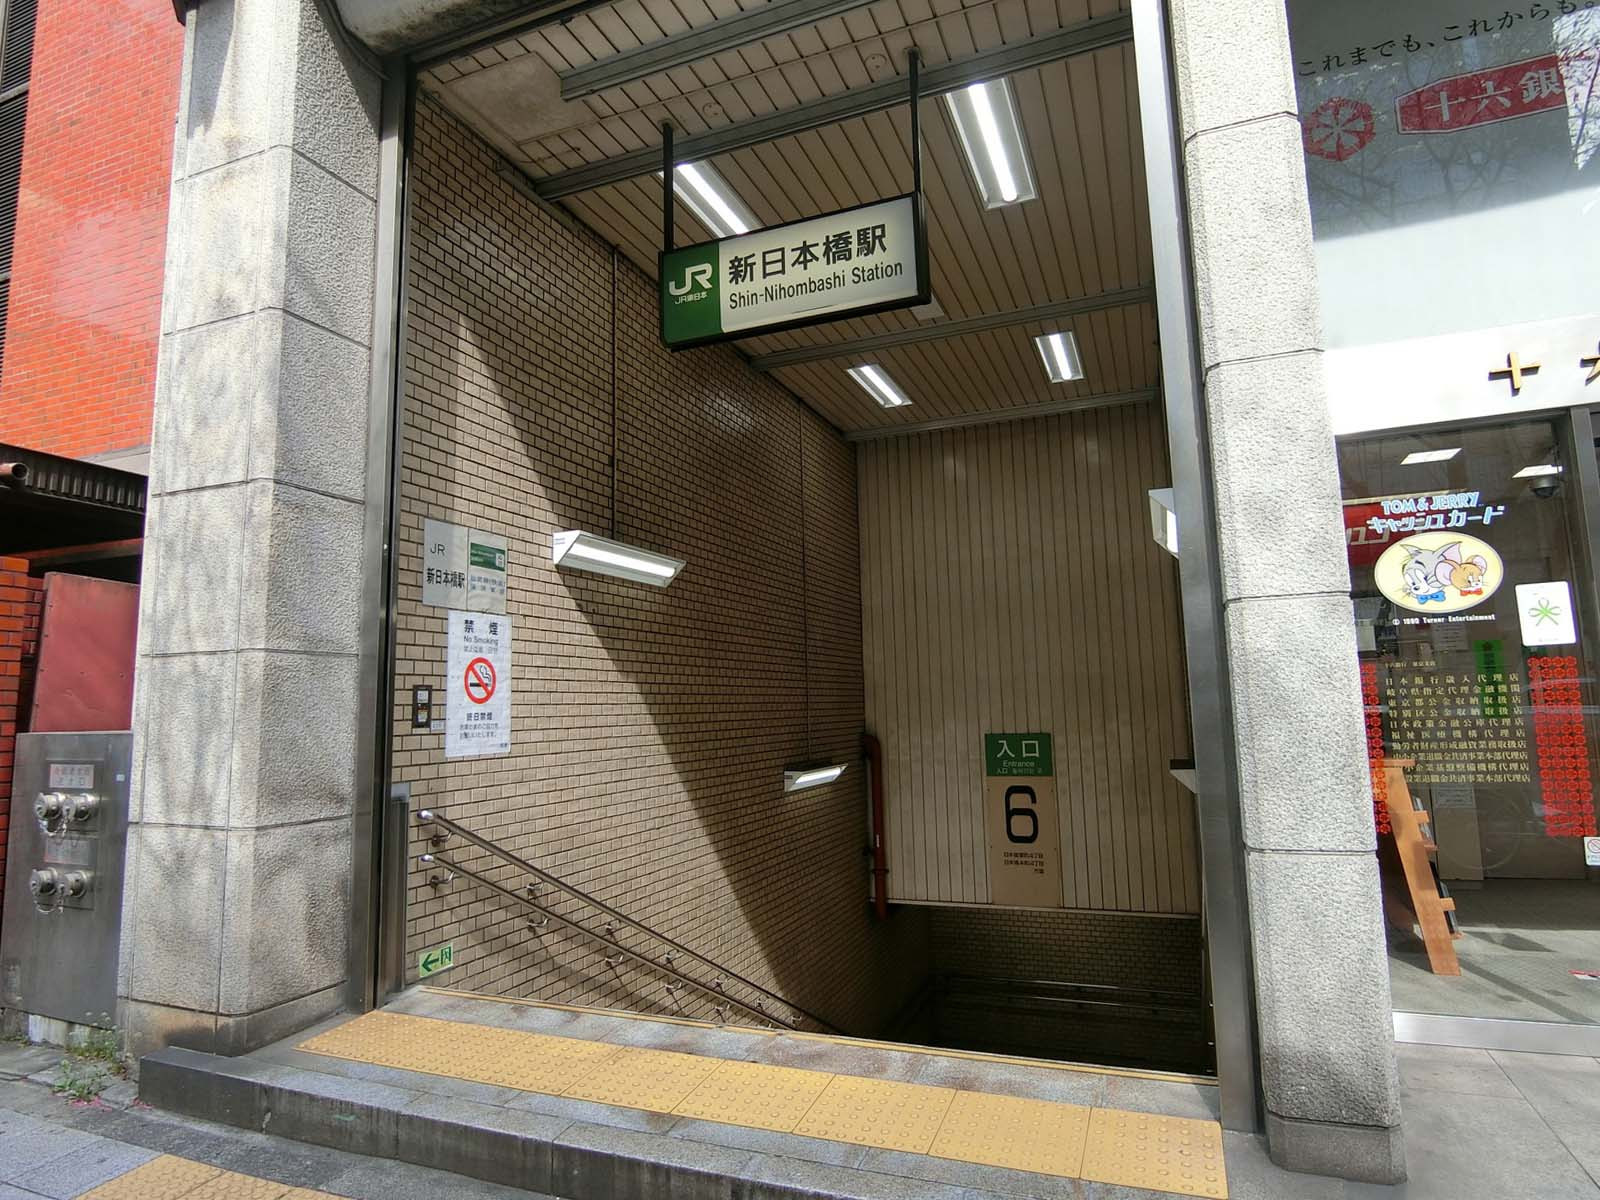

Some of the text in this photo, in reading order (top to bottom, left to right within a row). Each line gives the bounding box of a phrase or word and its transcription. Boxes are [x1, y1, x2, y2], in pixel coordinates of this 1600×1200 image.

[1299, 0, 1595, 76] これまでも、これからも。
[728, 223, 888, 286] 新日本橋駅
[668, 262, 713, 296] JR
[729, 261, 904, 310] Shin-Nihombashi Station
[1380, 491, 1480, 516] TOM & JERRY
[1366, 505, 1505, 534] キャッシュカード
[430, 543, 446, 556] JR
[426, 567, 466, 589] 新日本橋駅
[464, 619, 499, 636] 禁煙
[464, 635, 499, 646] No Smoking
[996, 740, 1040, 758] 入口
[1002, 760, 1035, 768] Entrance
[1004, 785, 1039, 844] 6
